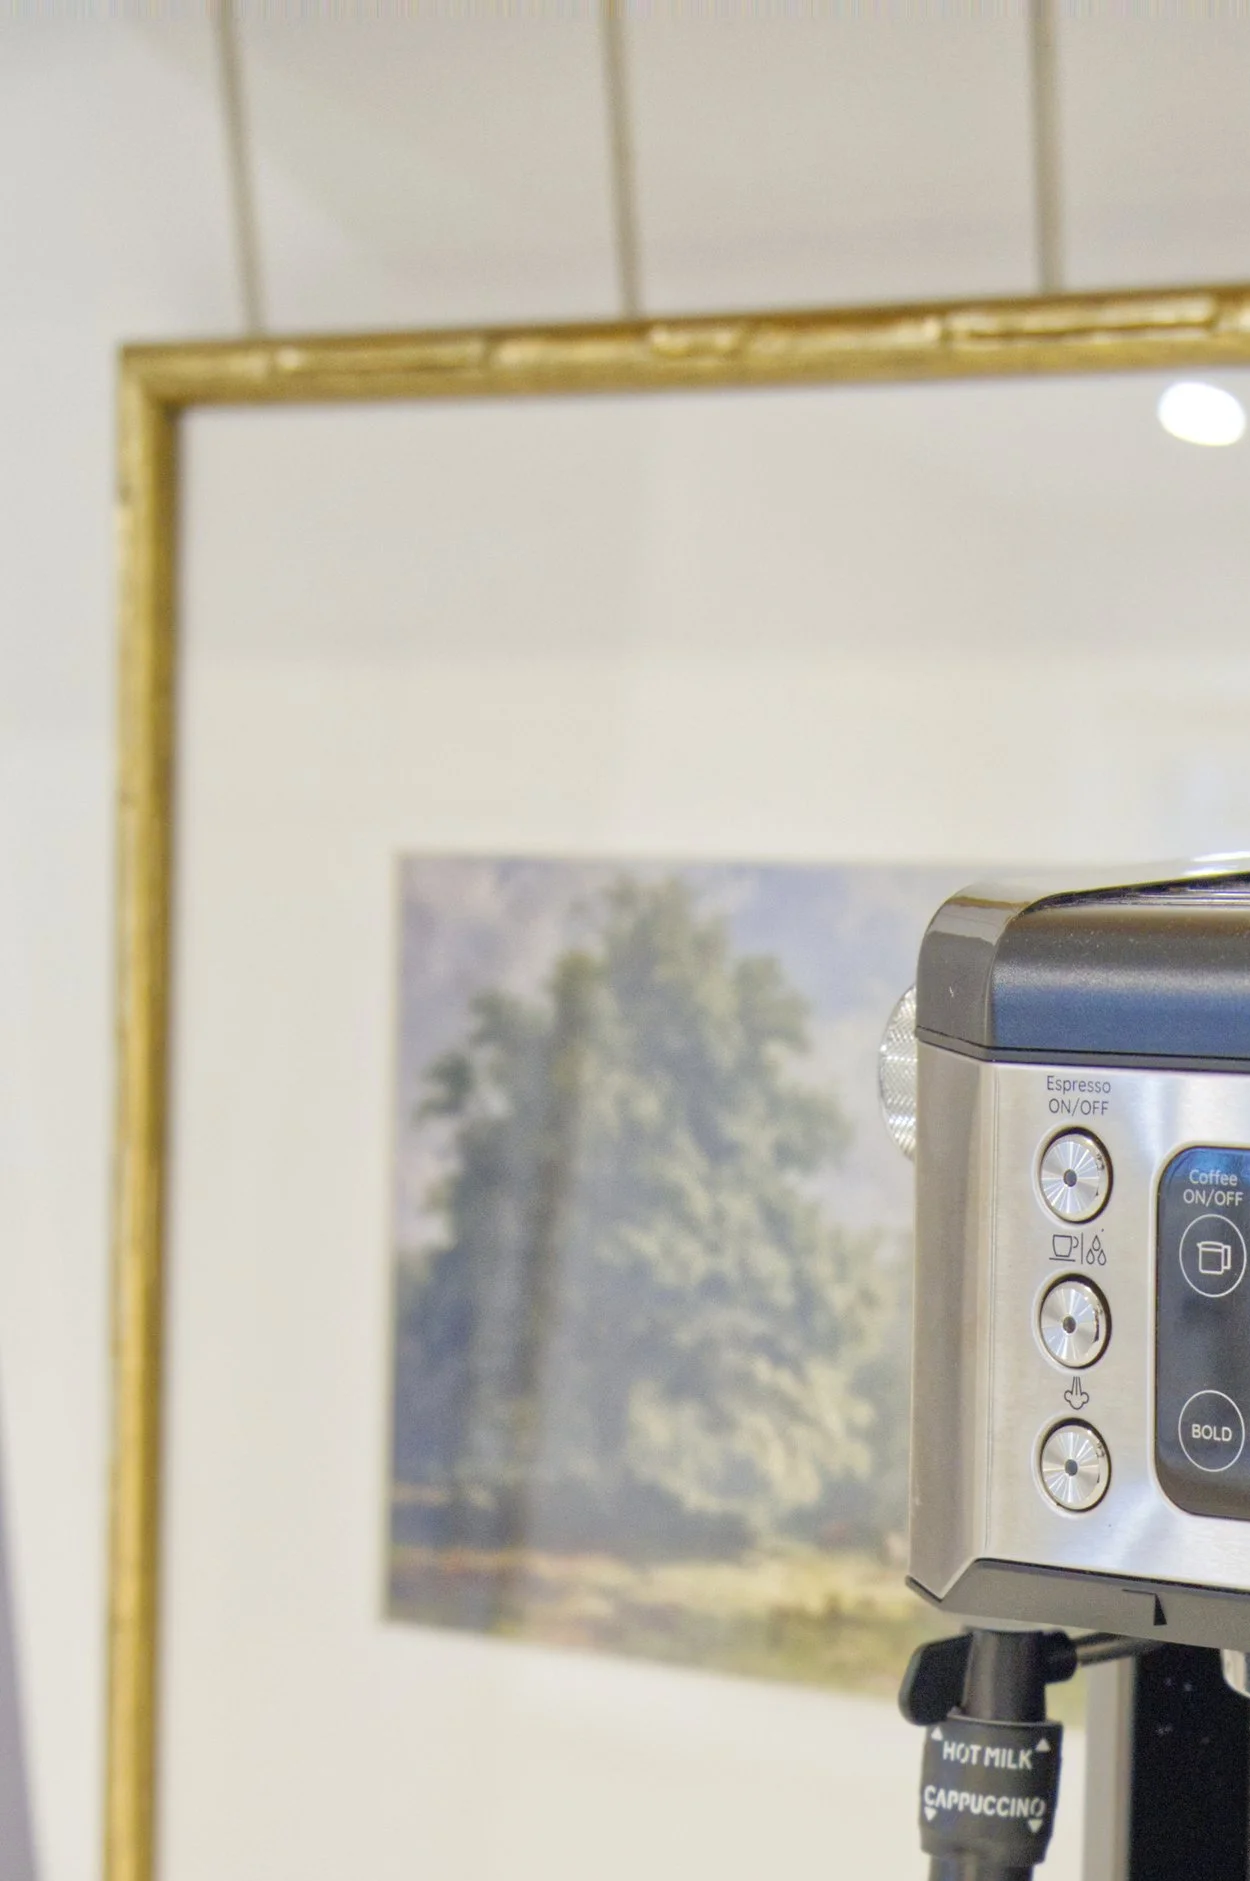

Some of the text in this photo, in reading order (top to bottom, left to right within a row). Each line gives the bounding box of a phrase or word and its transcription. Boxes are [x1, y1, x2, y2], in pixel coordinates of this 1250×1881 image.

[1047, 1075, 1111, 1095] Espresso
[1048, 1098, 1109, 1116] ON/OFF
[1188, 1168, 1238, 1186] Coffee
[1183, 1189, 1243, 1207] ON/OFF
[1191, 1424, 1233, 1443] BOLD
[943, 1741, 1032, 1770] HOT MILK
[924, 1785, 1045, 1817] CAPPUCCINO
